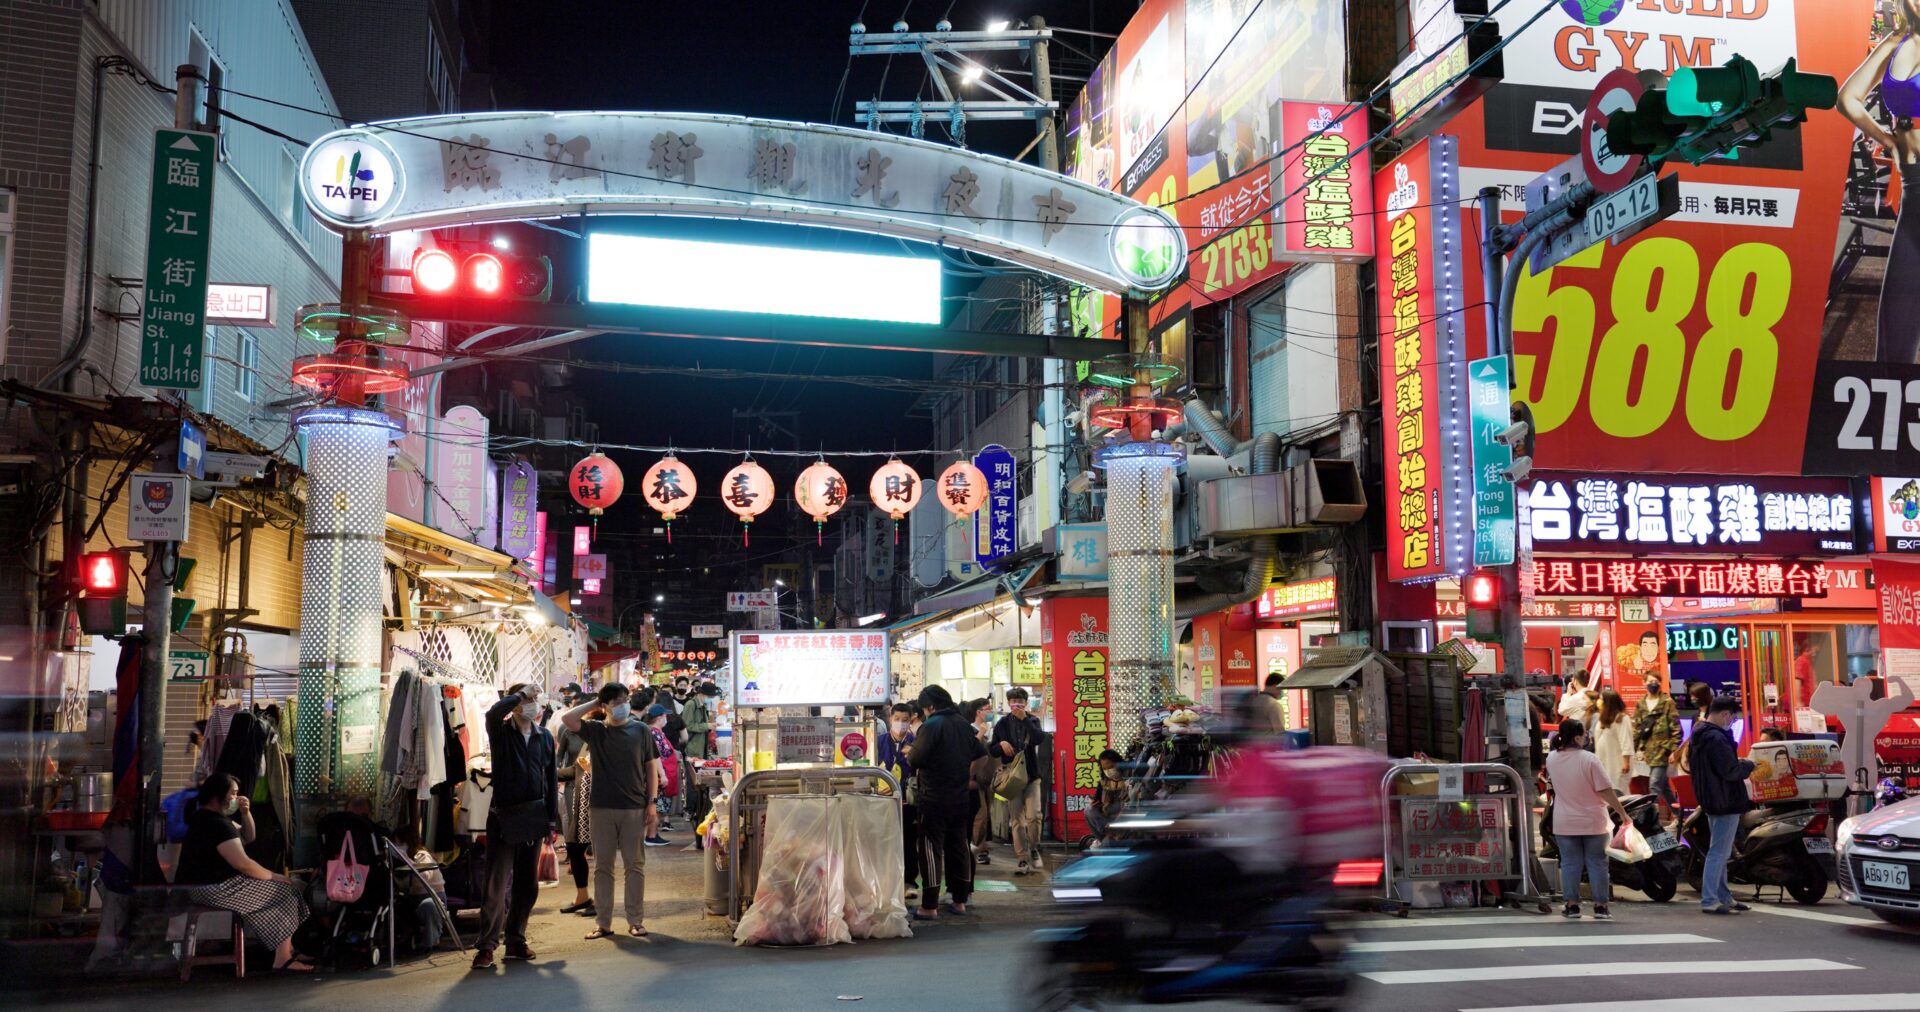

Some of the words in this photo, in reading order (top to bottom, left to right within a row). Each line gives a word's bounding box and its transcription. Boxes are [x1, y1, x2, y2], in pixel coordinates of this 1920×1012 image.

[1553, 24, 1716, 78] GYM
[441, 131, 1078, 247] 臨江街觀光夜市
[1200, 174, 1270, 238] 就從今天
[1593, 182, 1651, 236] 09-12
[161, 157, 201, 288] 臨江街
[149, 288, 176, 304] Lin
[147, 306, 196, 326] Jiang
[146, 324, 170, 340] St.
[1510, 237, 1793, 441] 588
[142, 365, 169, 381] 103
[173, 367, 200, 383] 116
[1479, 381, 1504, 487] 通化街
[650, 470, 689, 503] 恭
[725, 473, 759, 508] 喜
[885, 473, 916, 503] 財
[1477, 490, 1505, 503] Tong
[993, 462, 1012, 557] 明和百貨皮件
[1478, 504, 1500, 515] Hua
[1478, 518, 1493, 530] St.
[1478, 551, 1490, 562] 77
[1629, 609, 1643, 620] 77
[171, 662, 197, 681] 73
